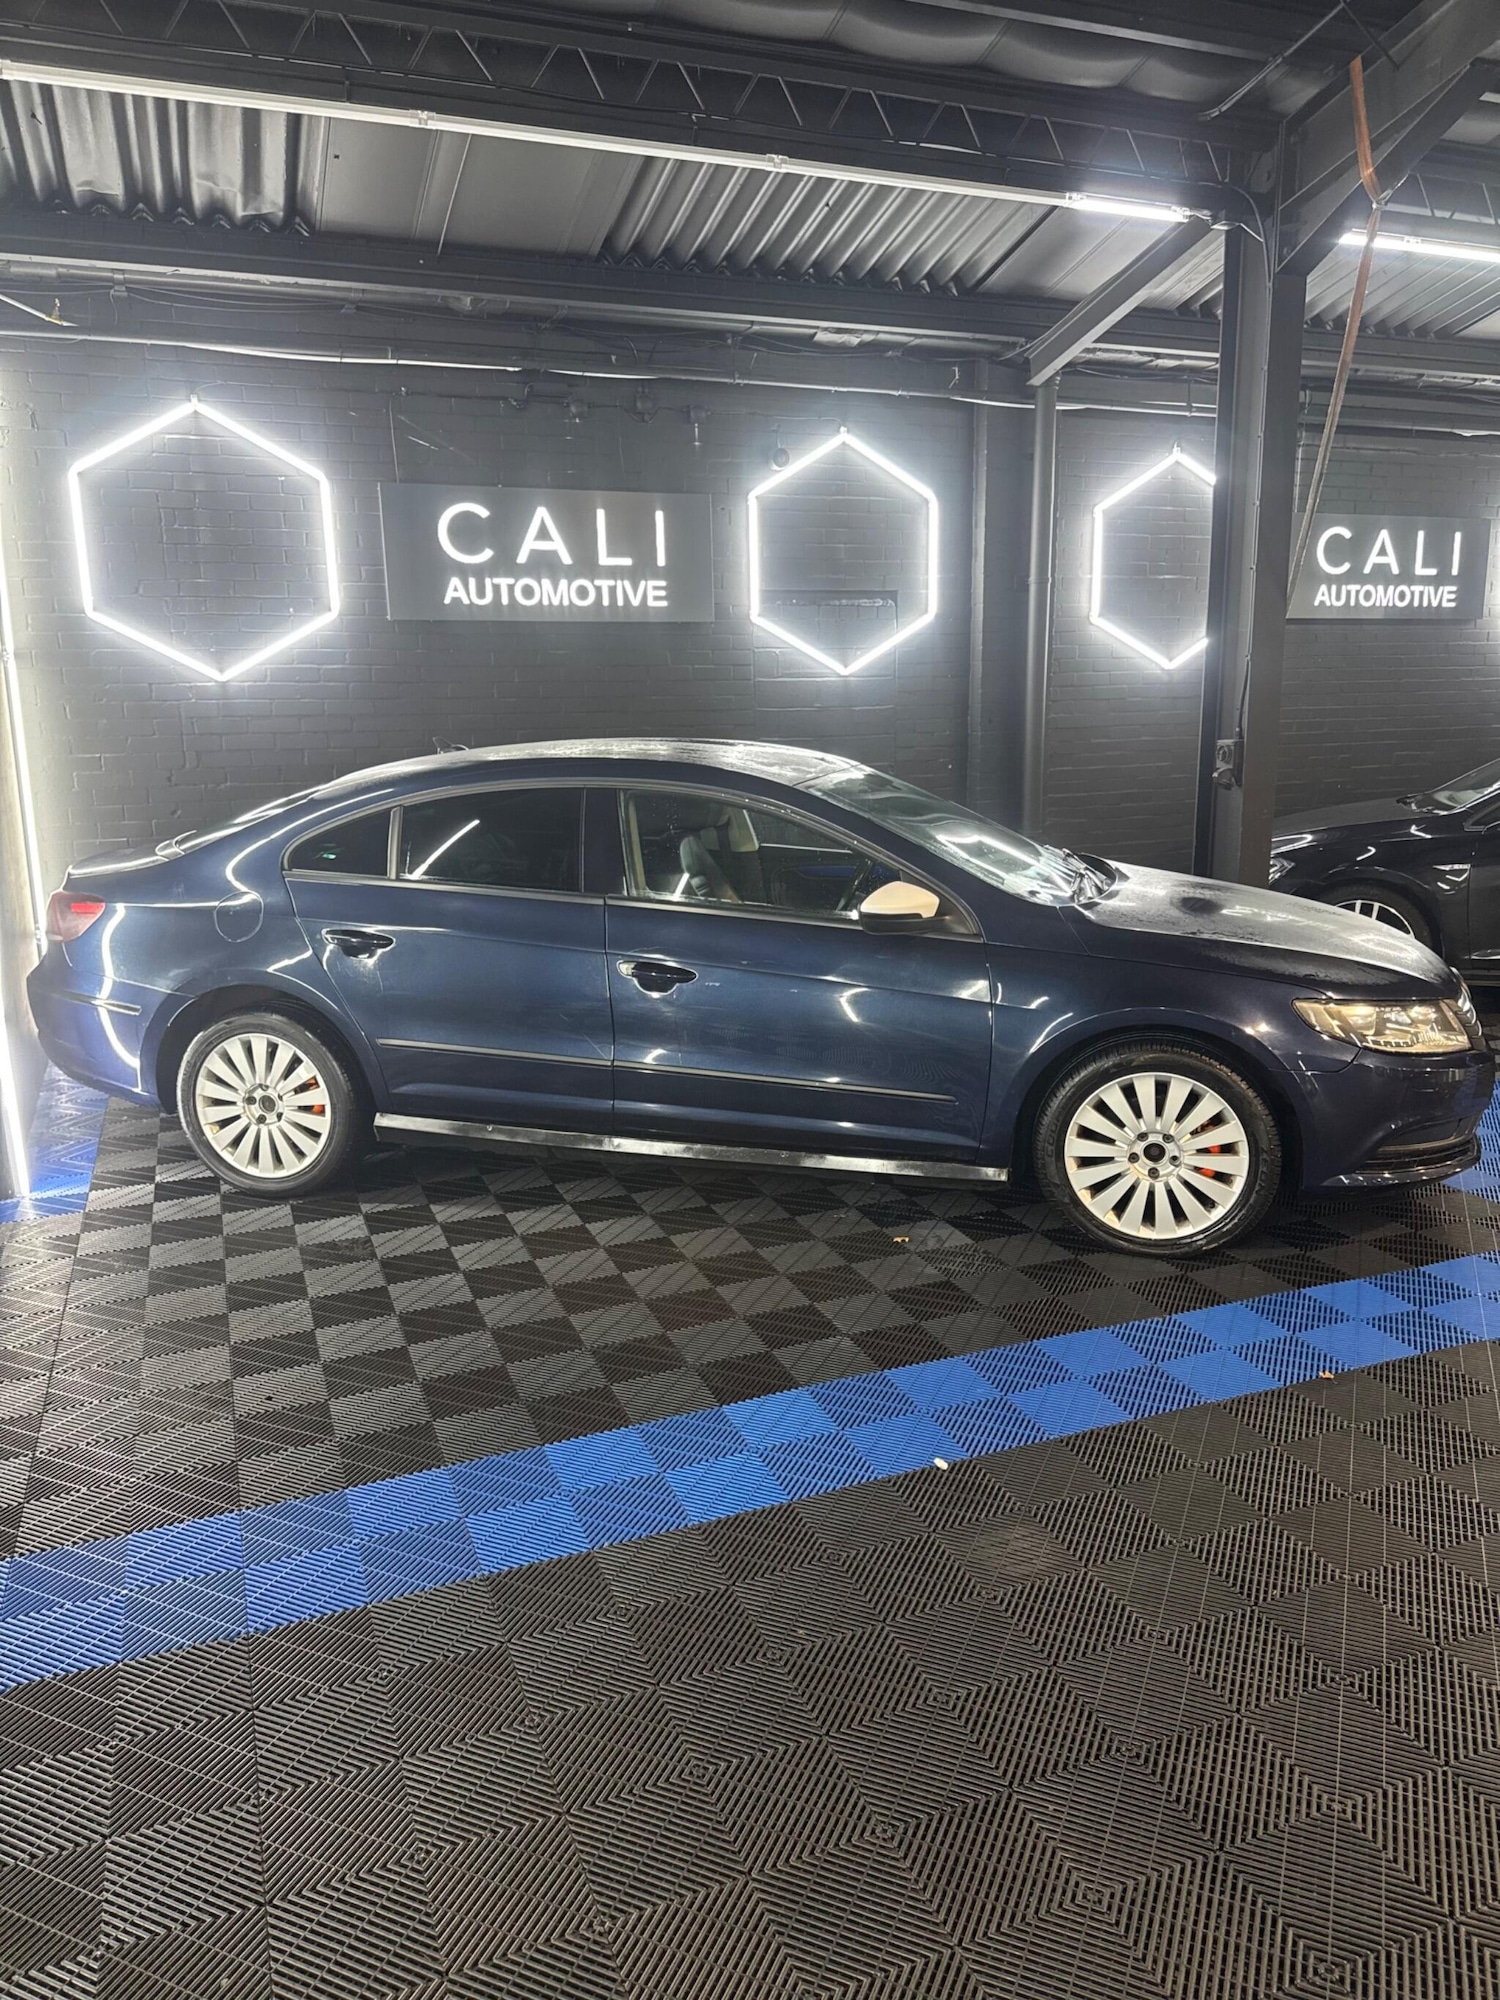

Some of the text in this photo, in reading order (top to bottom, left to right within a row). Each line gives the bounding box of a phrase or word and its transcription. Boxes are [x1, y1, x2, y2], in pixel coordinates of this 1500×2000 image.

[437, 501, 667, 567] CALI
[1316, 525, 1462, 576] CALI
[443, 576, 669, 608] AUTOMOTIVE
[1313, 583, 1458, 608] AUTOMOTIVE
